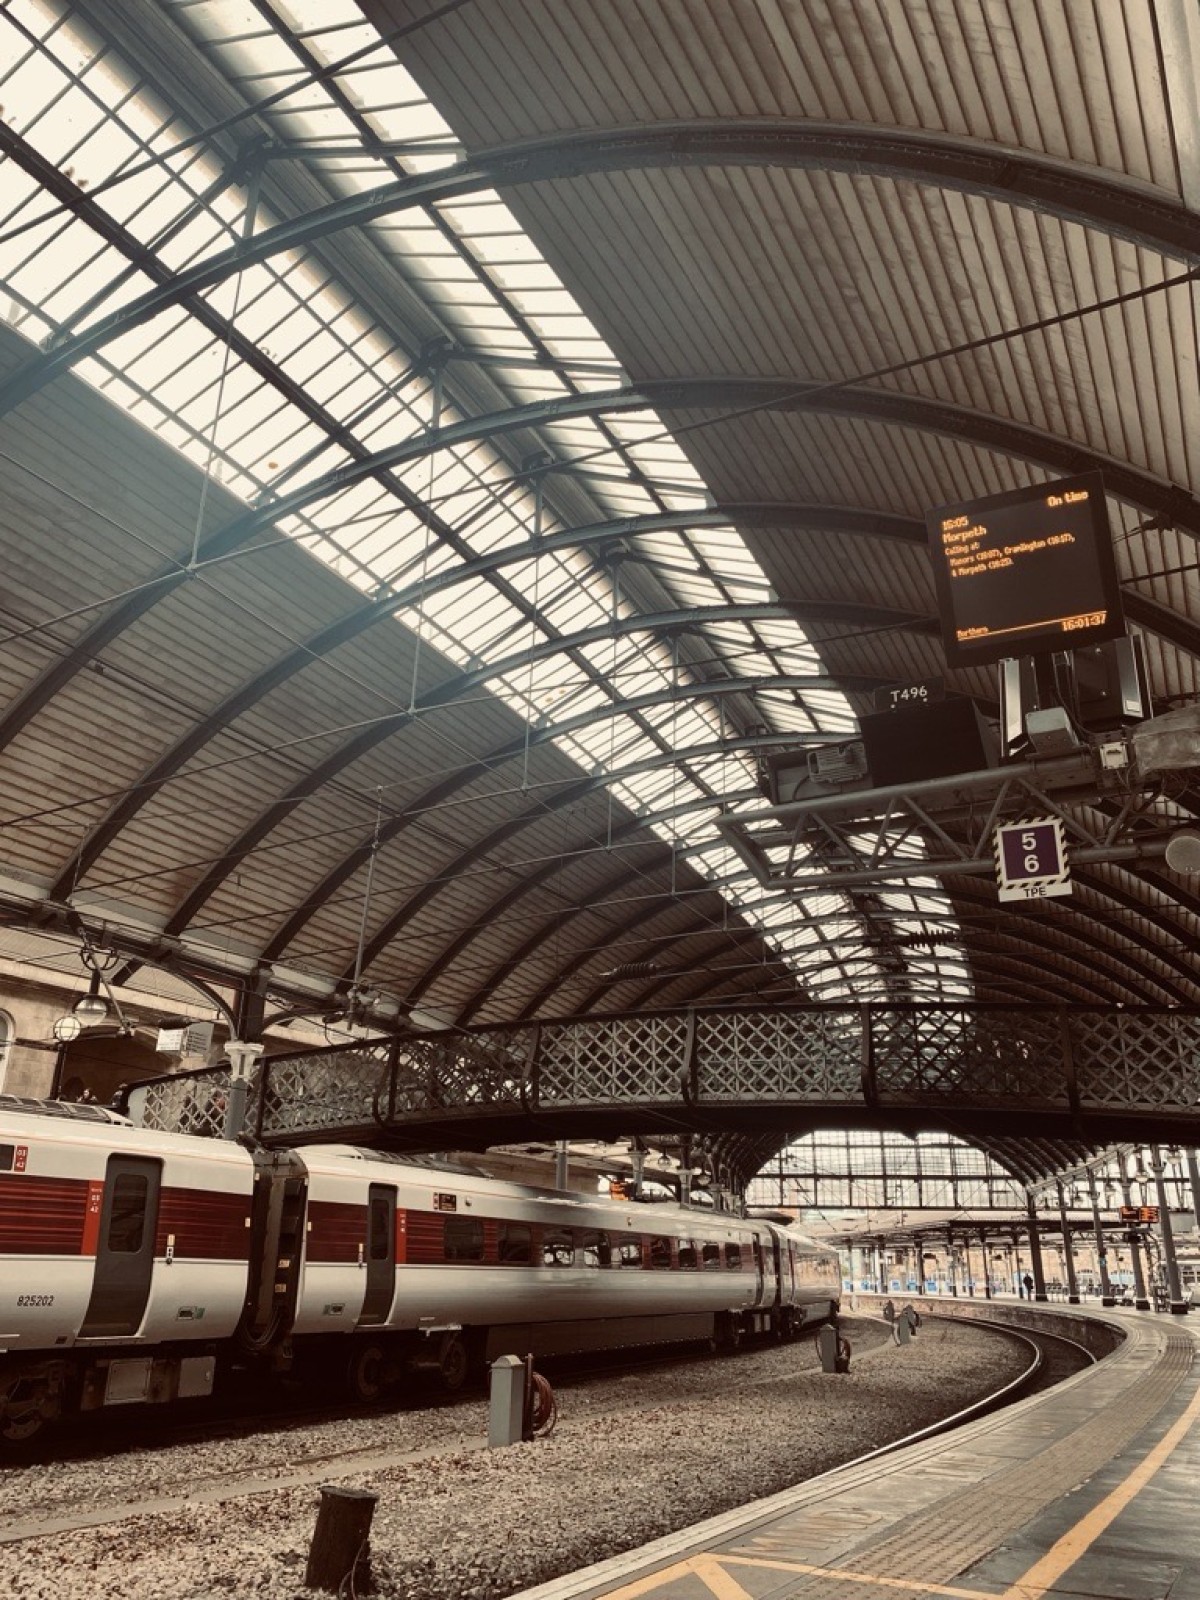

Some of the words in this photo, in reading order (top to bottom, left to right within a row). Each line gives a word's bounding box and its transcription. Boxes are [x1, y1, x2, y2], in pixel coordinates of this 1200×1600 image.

[1047, 496, 1063, 507] On
[1065, 491, 1088, 503] time
[943, 516, 968, 530] 16:05
[943, 526, 987, 543] Morpeth
[945, 543, 969, 556] Calling
[1062, 614, 1107, 631] 16:01:37
[890, 685, 928, 702] T496
[1021, 832, 1037, 851] 5
[1024, 854, 1040, 873] 6
[1024, 886, 1048, 898] TPE
[16, 1295, 55, 1307] 825202
